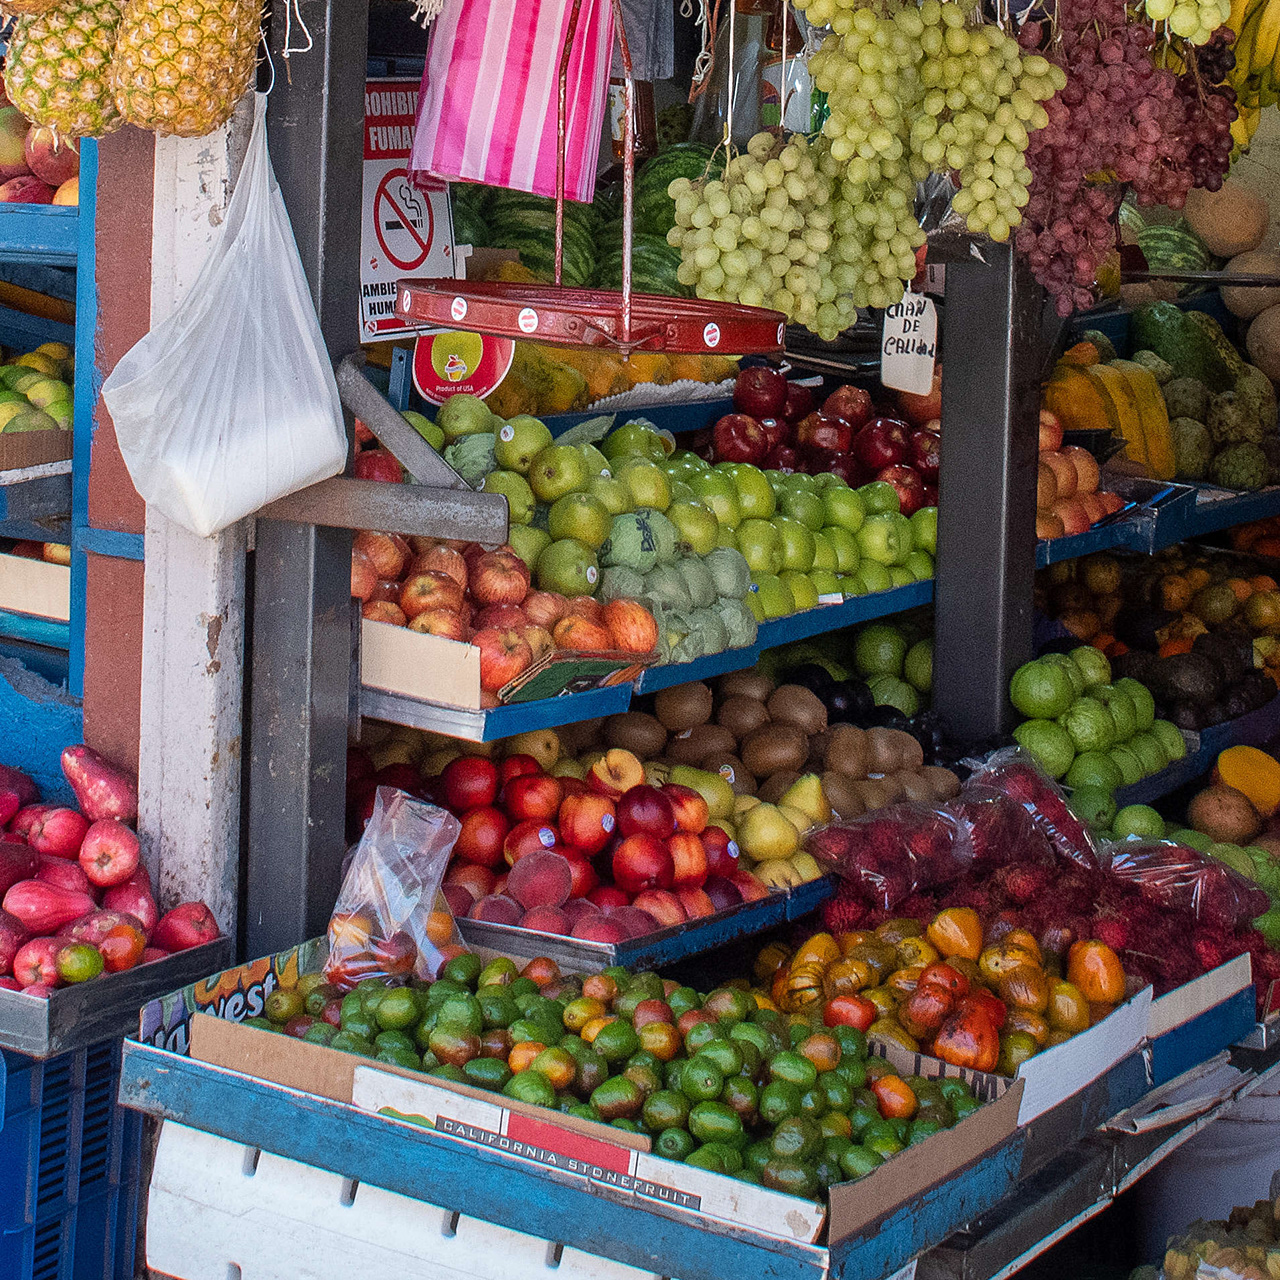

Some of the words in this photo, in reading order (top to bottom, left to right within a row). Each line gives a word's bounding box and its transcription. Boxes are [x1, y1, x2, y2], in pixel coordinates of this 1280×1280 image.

[903, 319, 920, 333] DE
[444, 1120, 557, 1165] CALIFORNIA
[568, 1159, 691, 1206] STONEFRUIT
